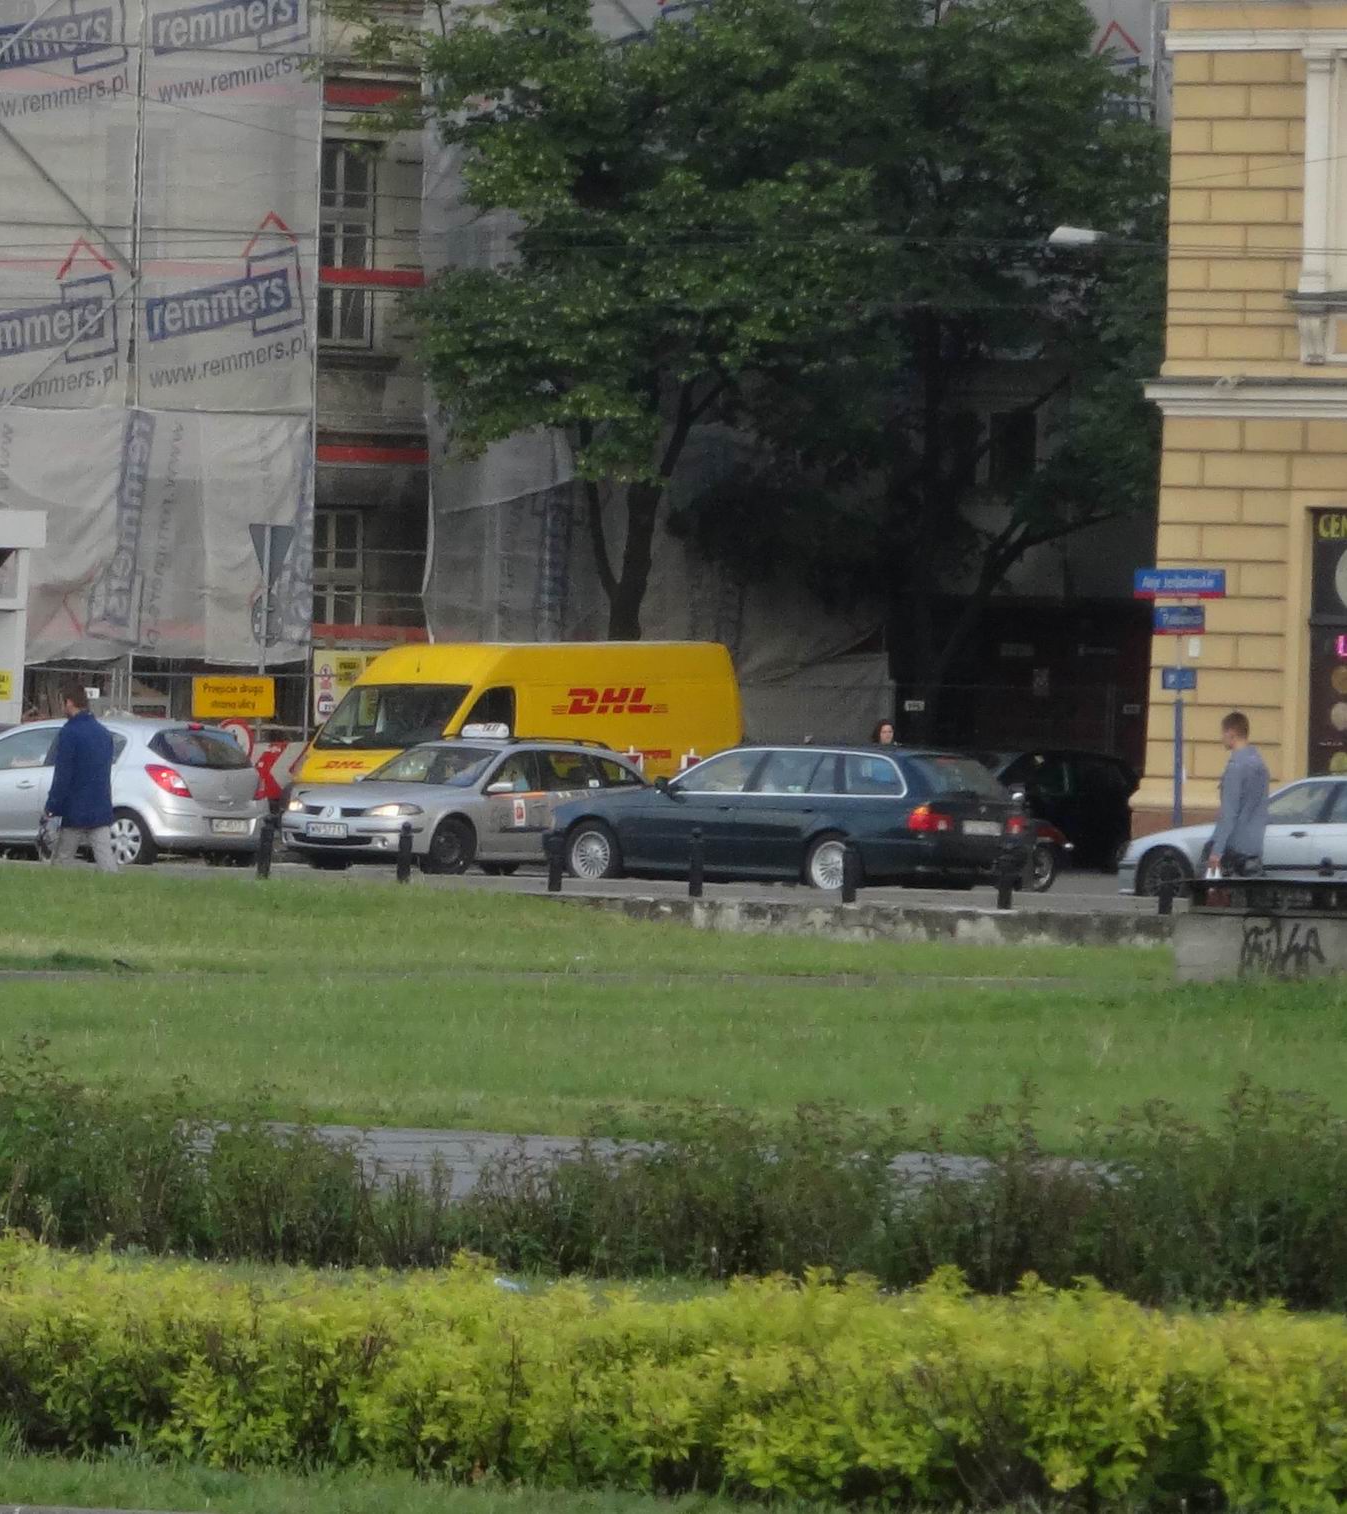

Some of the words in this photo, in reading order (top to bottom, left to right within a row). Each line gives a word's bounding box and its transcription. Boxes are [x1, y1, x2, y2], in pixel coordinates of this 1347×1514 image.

[157, 0, 293, 46] remmers
[154, 276, 287, 333] remmers
[150, 331, 307, 389] www.remmers.pl
[568, 687, 653, 715] DHL
[325, 761, 364, 769] DHL
